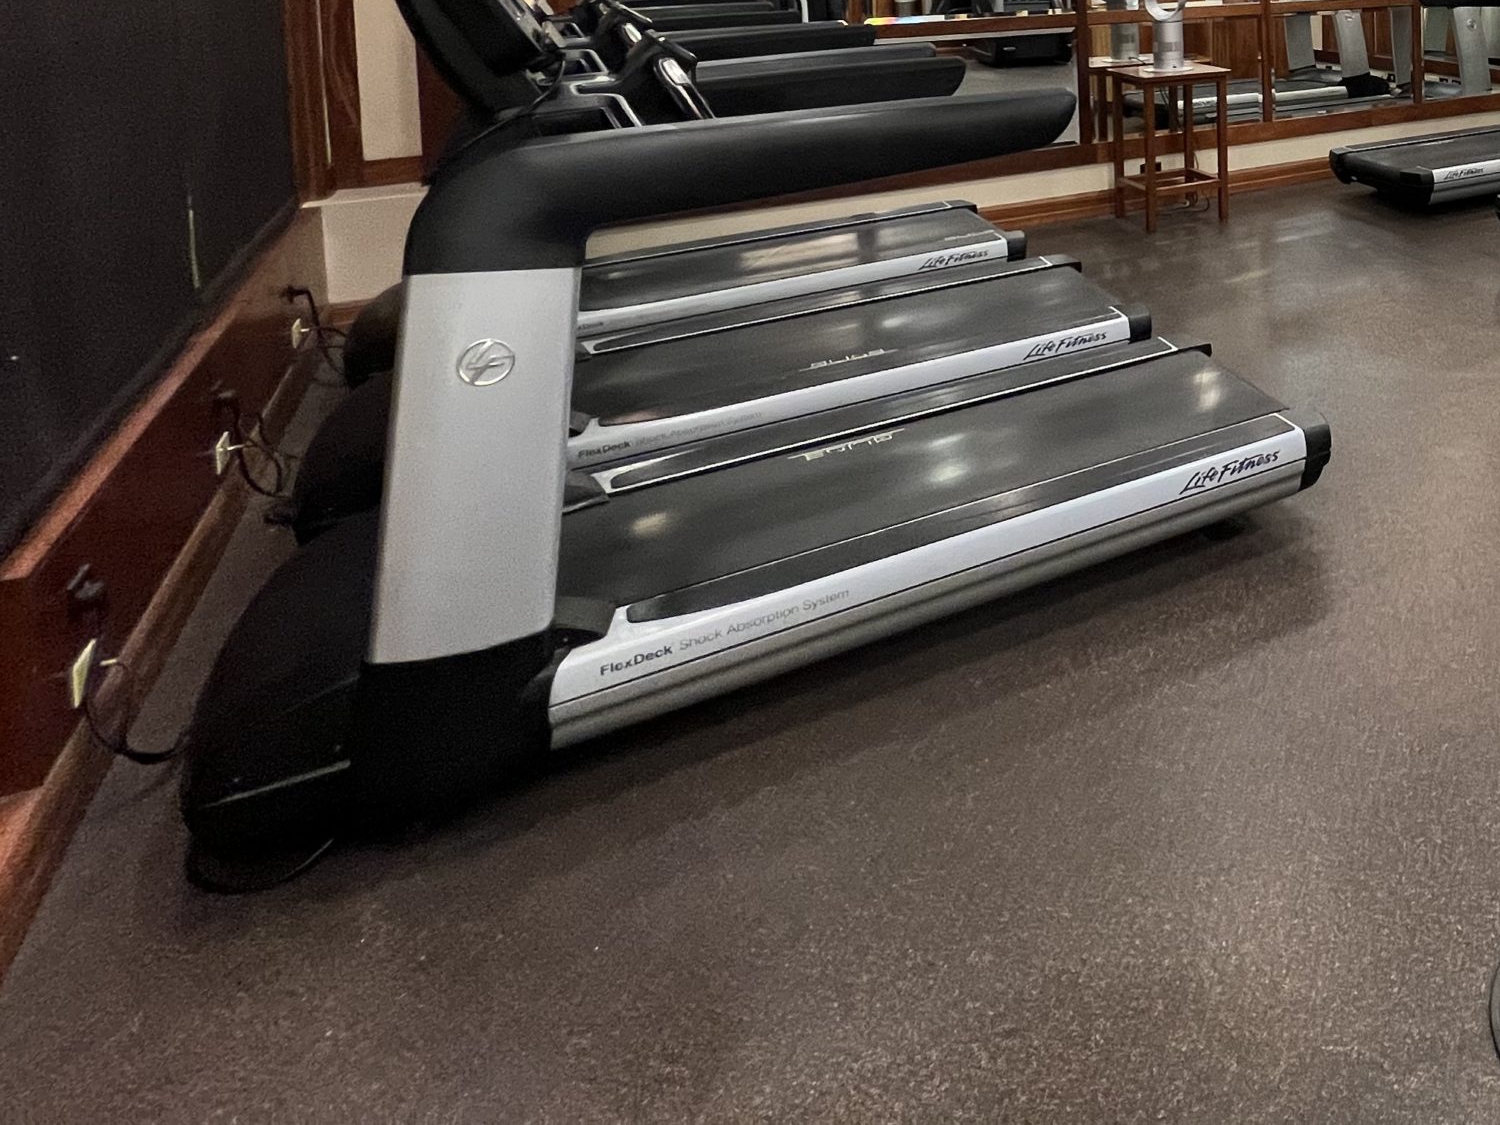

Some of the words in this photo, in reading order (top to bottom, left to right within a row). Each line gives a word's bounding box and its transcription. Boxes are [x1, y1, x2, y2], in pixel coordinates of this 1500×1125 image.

[600, 644, 673, 676] FlexDeck
[679, 630, 723, 651] Shock
[726, 606, 800, 636] Absorption
[802, 588, 850, 613] System
